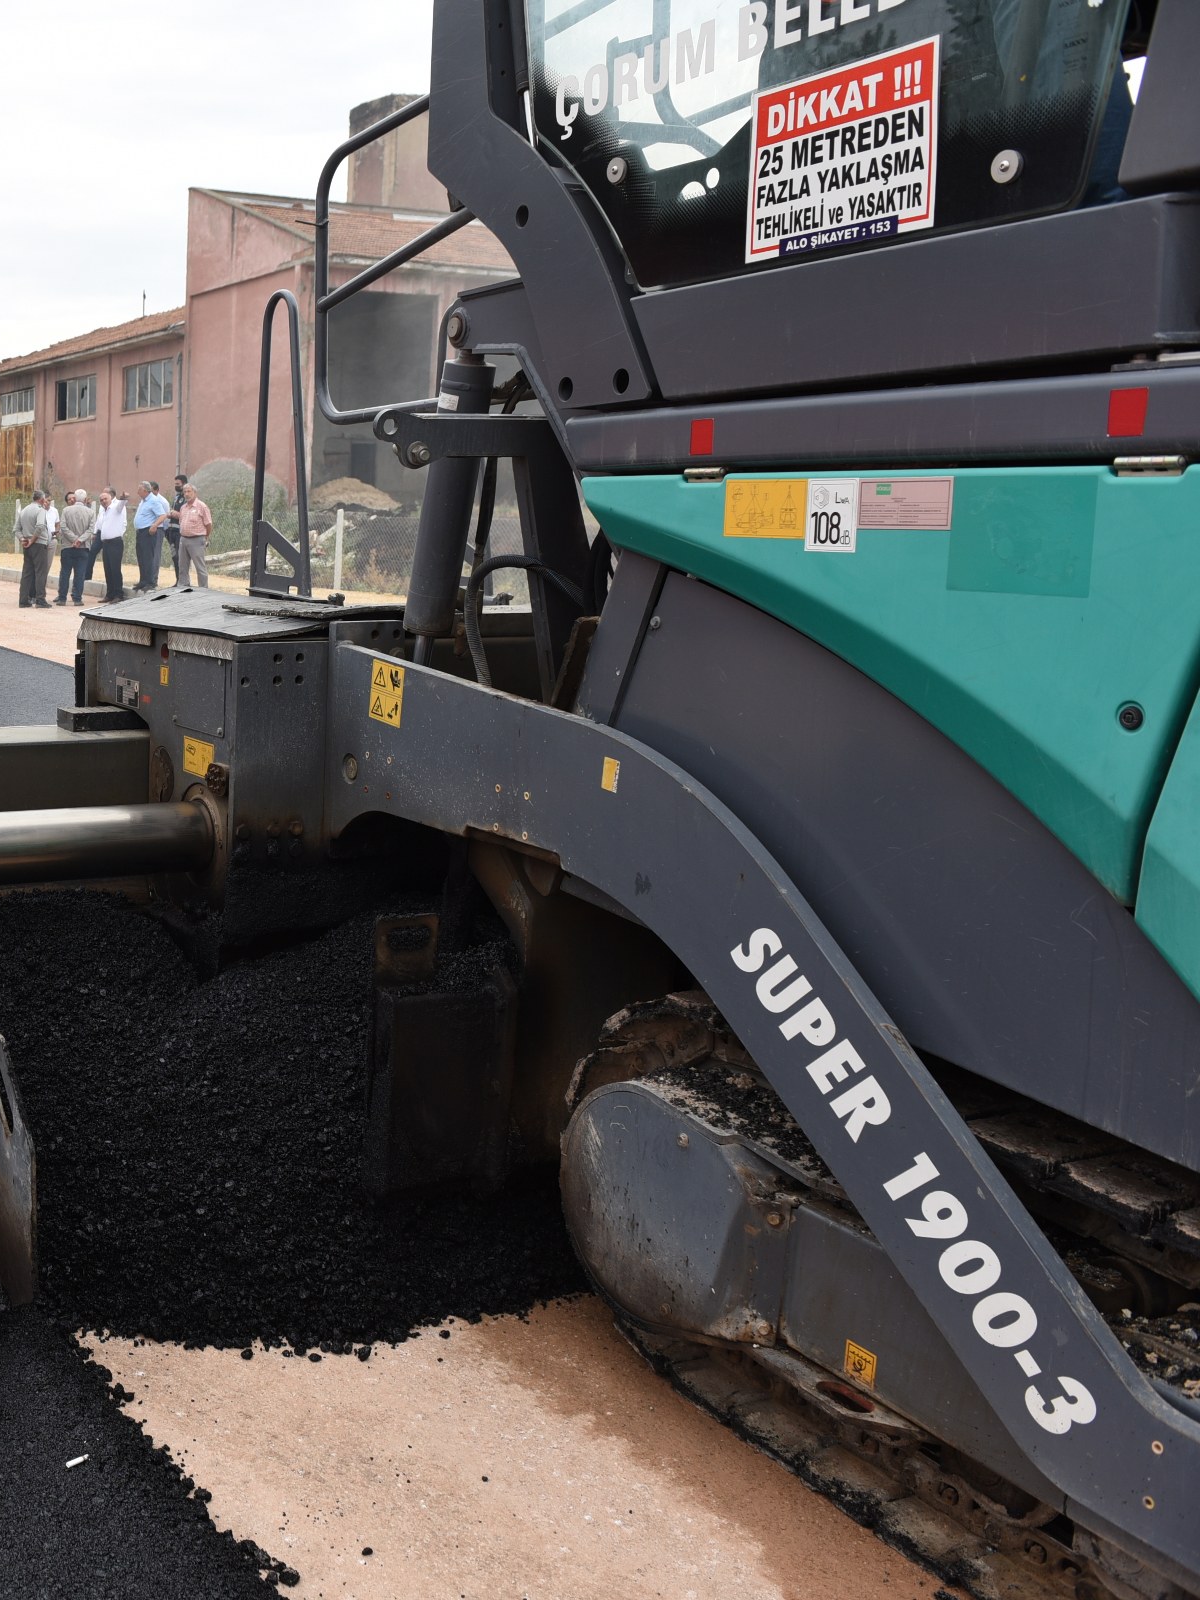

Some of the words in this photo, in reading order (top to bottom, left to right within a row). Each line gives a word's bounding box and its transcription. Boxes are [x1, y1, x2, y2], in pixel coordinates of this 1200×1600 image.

[556, 19, 715, 140] ÇORUM
[767, 71, 884, 137] DİKKAT
[894, 60, 922, 101] !!!
[756, 175, 811, 208] FAZLA
[816, 146, 925, 185] YAKLAŞMA
[758, 145, 784, 179] 25
[791, 106, 924, 170] METREDEN
[756, 199, 825, 240] TEHLİKELİ
[828, 205, 844, 223] ve
[849, 182, 922, 220] YASAKTIR
[785, 238, 808, 252] ALO
[810, 226, 860, 249] ŞİKAYET
[869, 220, 891, 234] 153
[810, 511, 841, 544] 108
[840, 529, 851, 545] dB
[730, 927, 892, 1143] SUPER
[882, 1151, 1097, 1435] 1900-3
